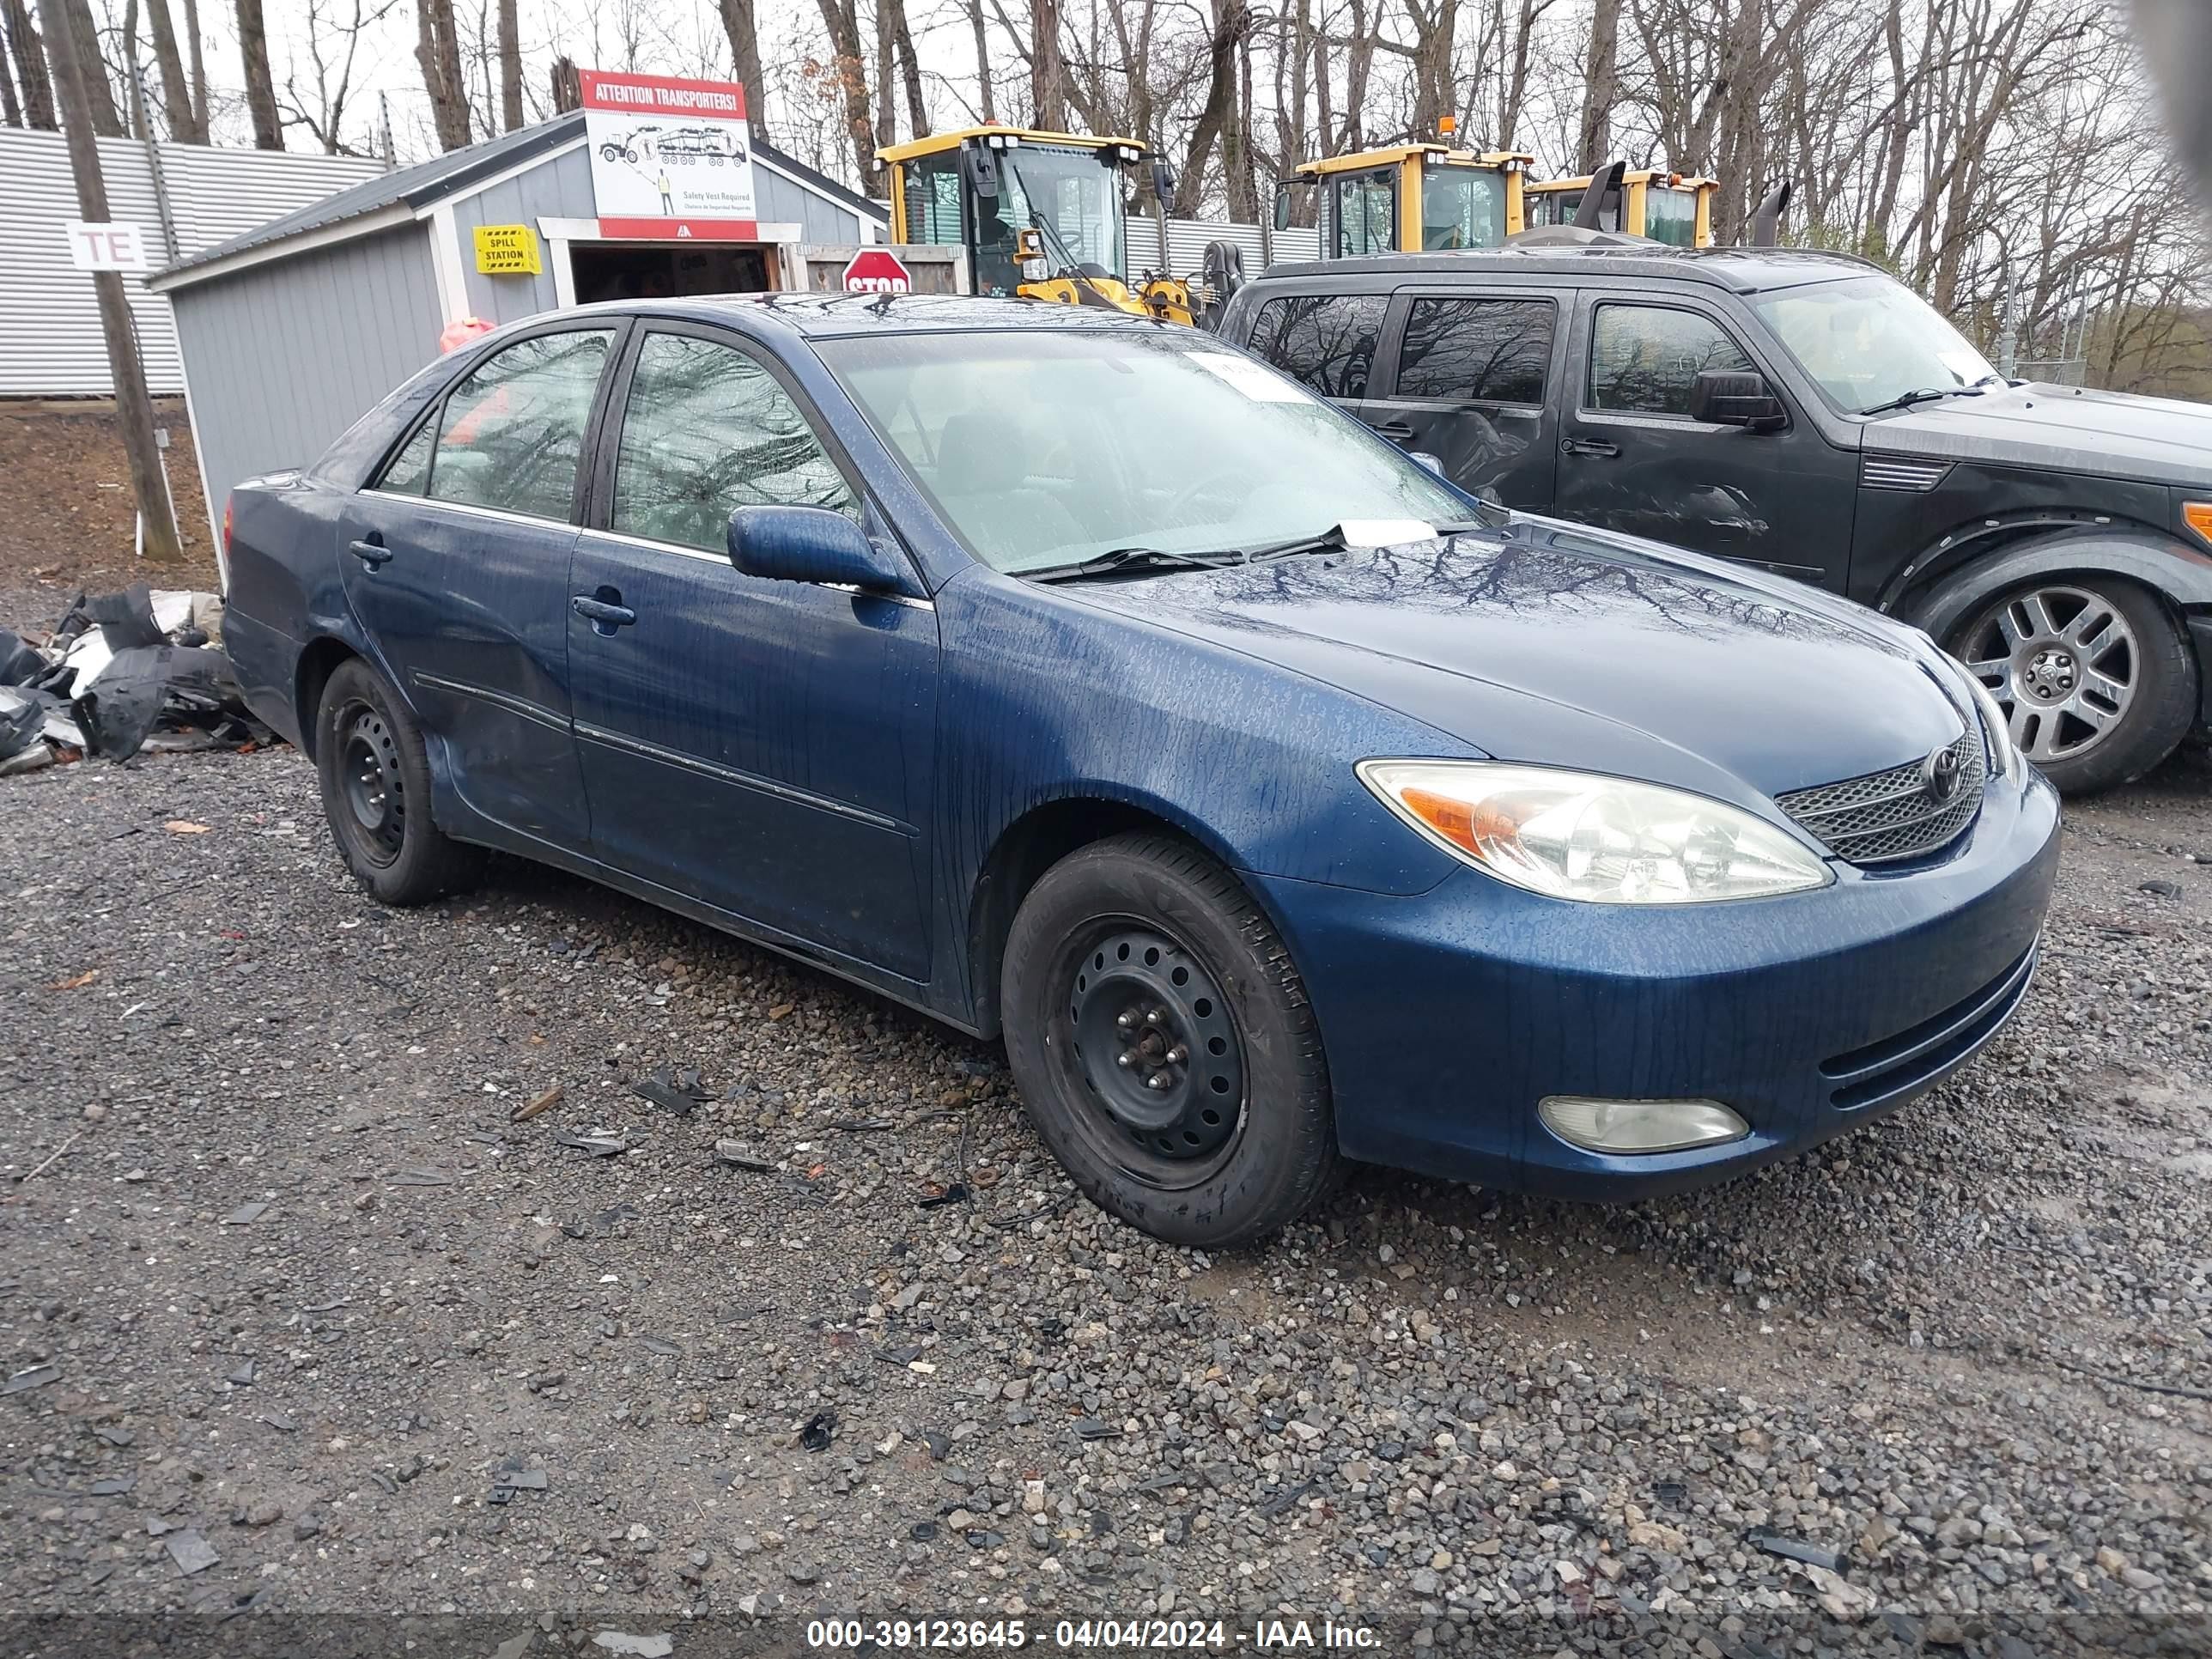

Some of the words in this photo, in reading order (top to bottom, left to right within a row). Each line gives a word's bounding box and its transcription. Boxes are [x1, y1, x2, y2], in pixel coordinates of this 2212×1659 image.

[596, 83, 653, 104] ATTENTION
[654, 88, 737, 111] TRANSPORTERS!
[78, 232, 135, 262] TE
[490, 239, 515, 247] SPILL
[485, 250, 524, 260] STATION
[848, 277, 907, 293] STOP
